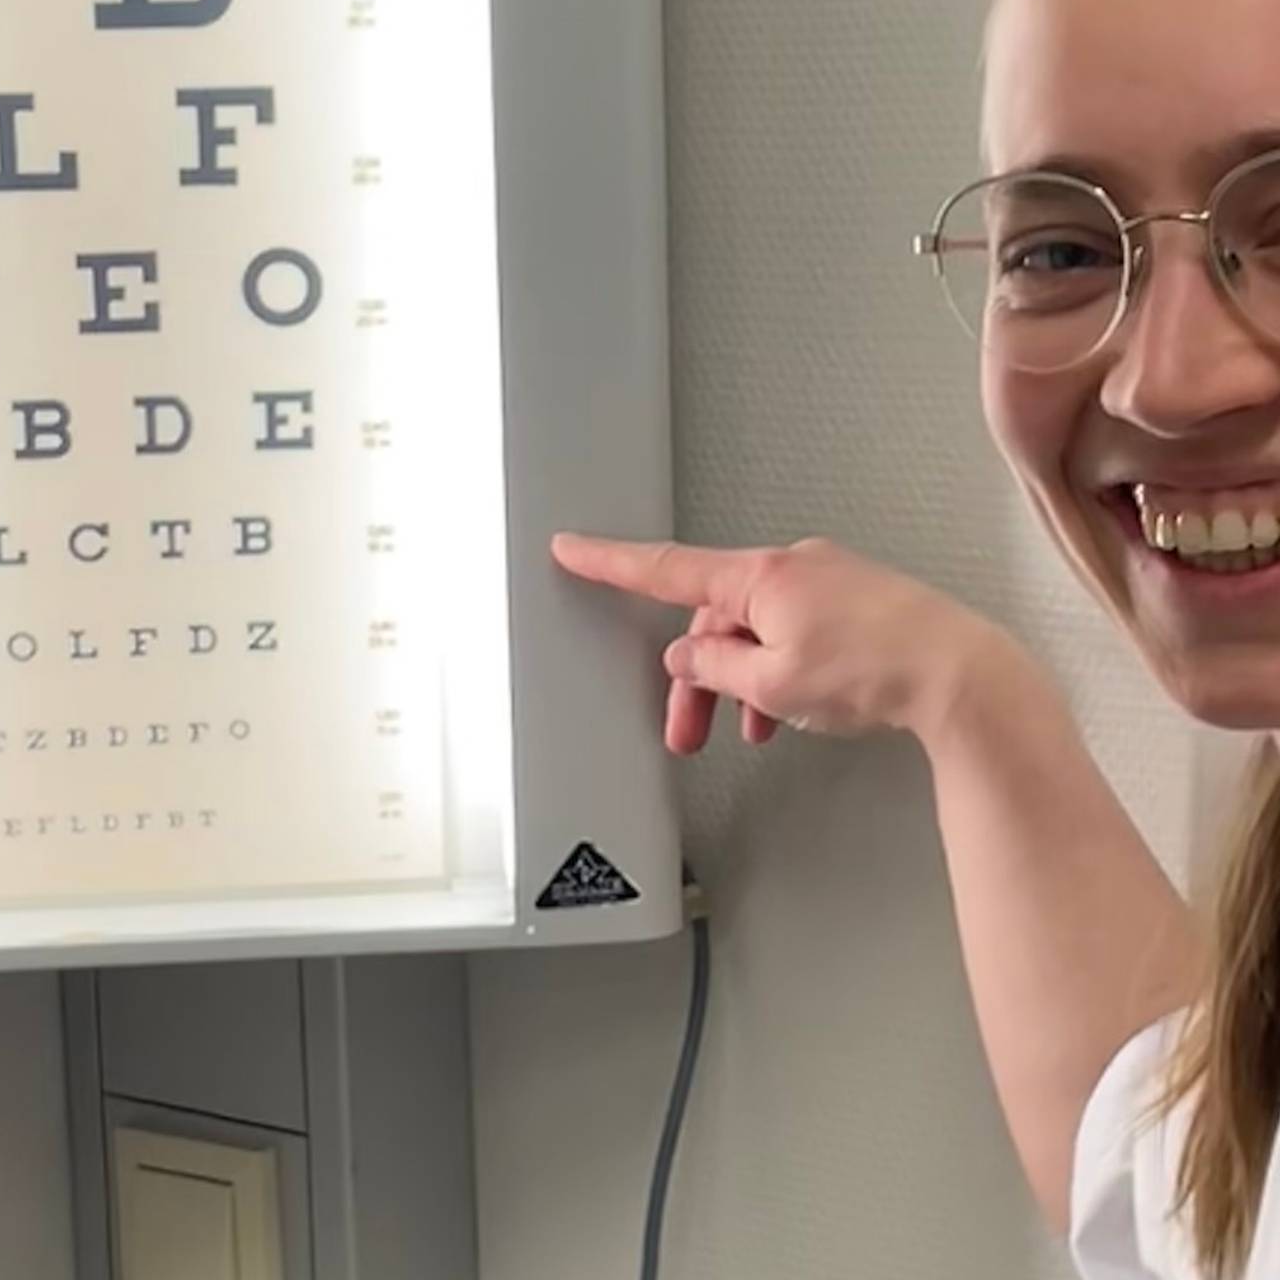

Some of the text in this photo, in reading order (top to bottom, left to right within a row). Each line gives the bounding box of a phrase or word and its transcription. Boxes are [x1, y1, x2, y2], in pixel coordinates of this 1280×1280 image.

[176, 87, 275, 186] F
[76, 251, 160, 335] E
[242, 248, 322, 327] O
[12, 400, 72, 460] B
[133, 396, 192, 455] D
[253, 391, 313, 450] E
[69, 523, 109, 562] C
[151, 520, 191, 559] T
[233, 517, 272, 555] B
[8, 634, 36, 661] O
[70, 631, 98, 658] L
[130, 629, 157, 656] F
[189, 625, 216, 653] D
[248, 622, 277, 650] Z
